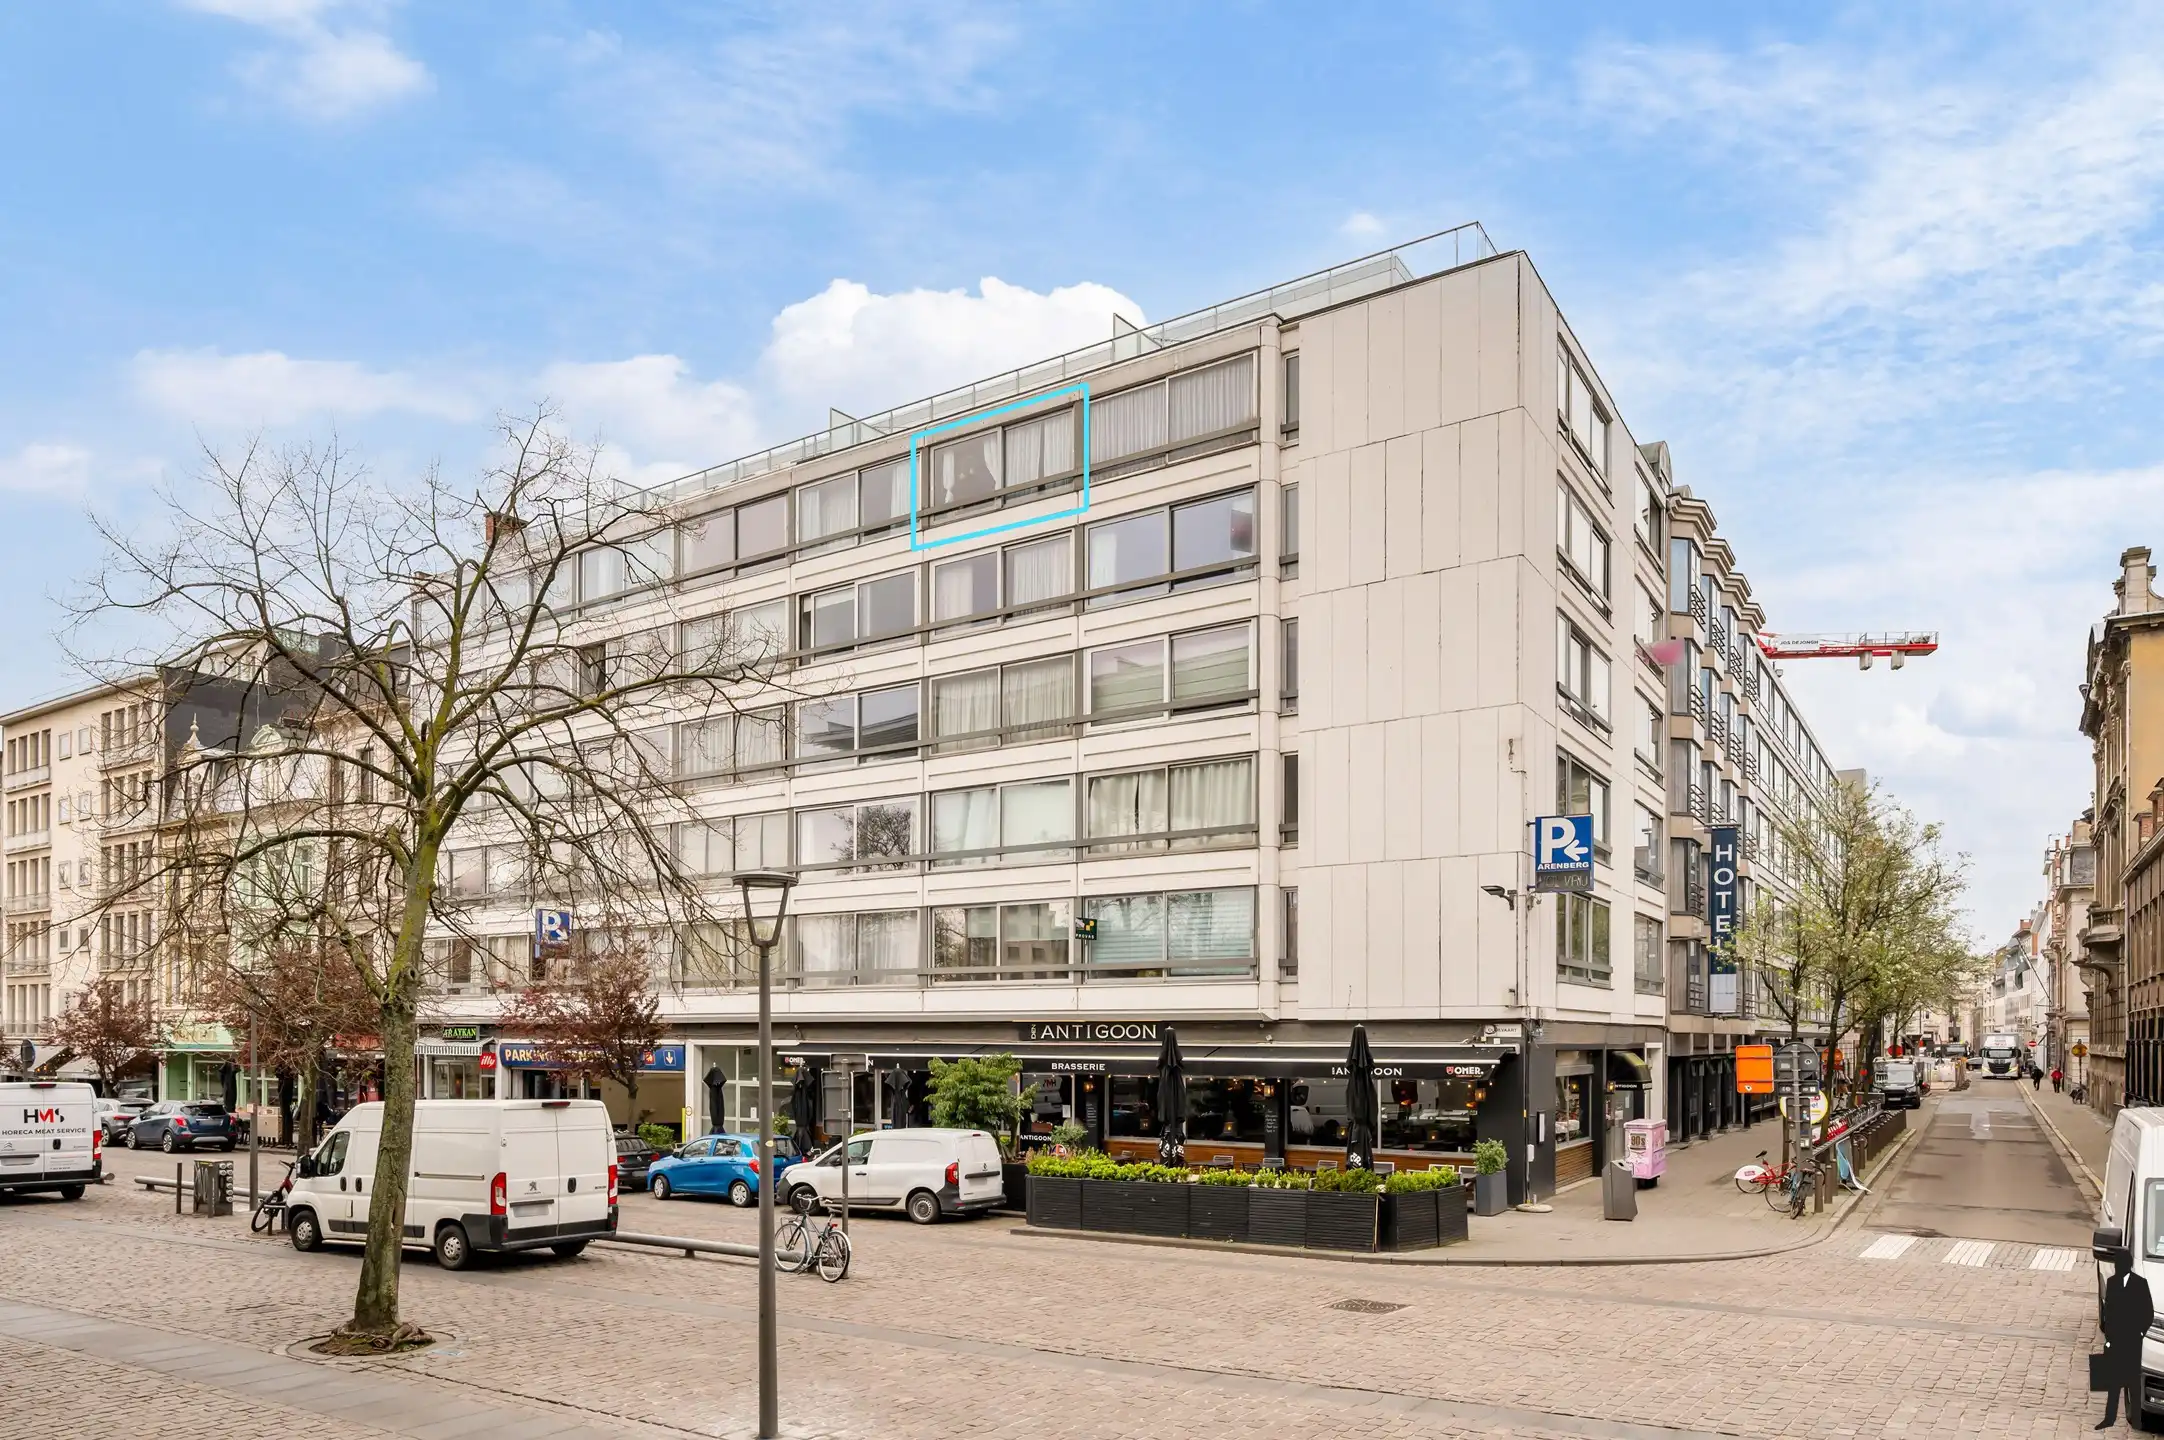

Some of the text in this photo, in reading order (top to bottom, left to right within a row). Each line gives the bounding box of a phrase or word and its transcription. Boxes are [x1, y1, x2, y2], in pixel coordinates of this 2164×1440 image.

[1541, 818, 1576, 863] P
[1537, 861, 1589, 870] ARENBERG
[542, 910, 561, 939] P
[1040, 1024, 1157, 1039] ANTIGOON
[481, 1056, 495, 1067] illy
[1051, 1062, 1106, 1071] BRASSERIE
[1335, 1067, 1403, 1076] ANOON
[23, 1108, 65, 1123] HMS
